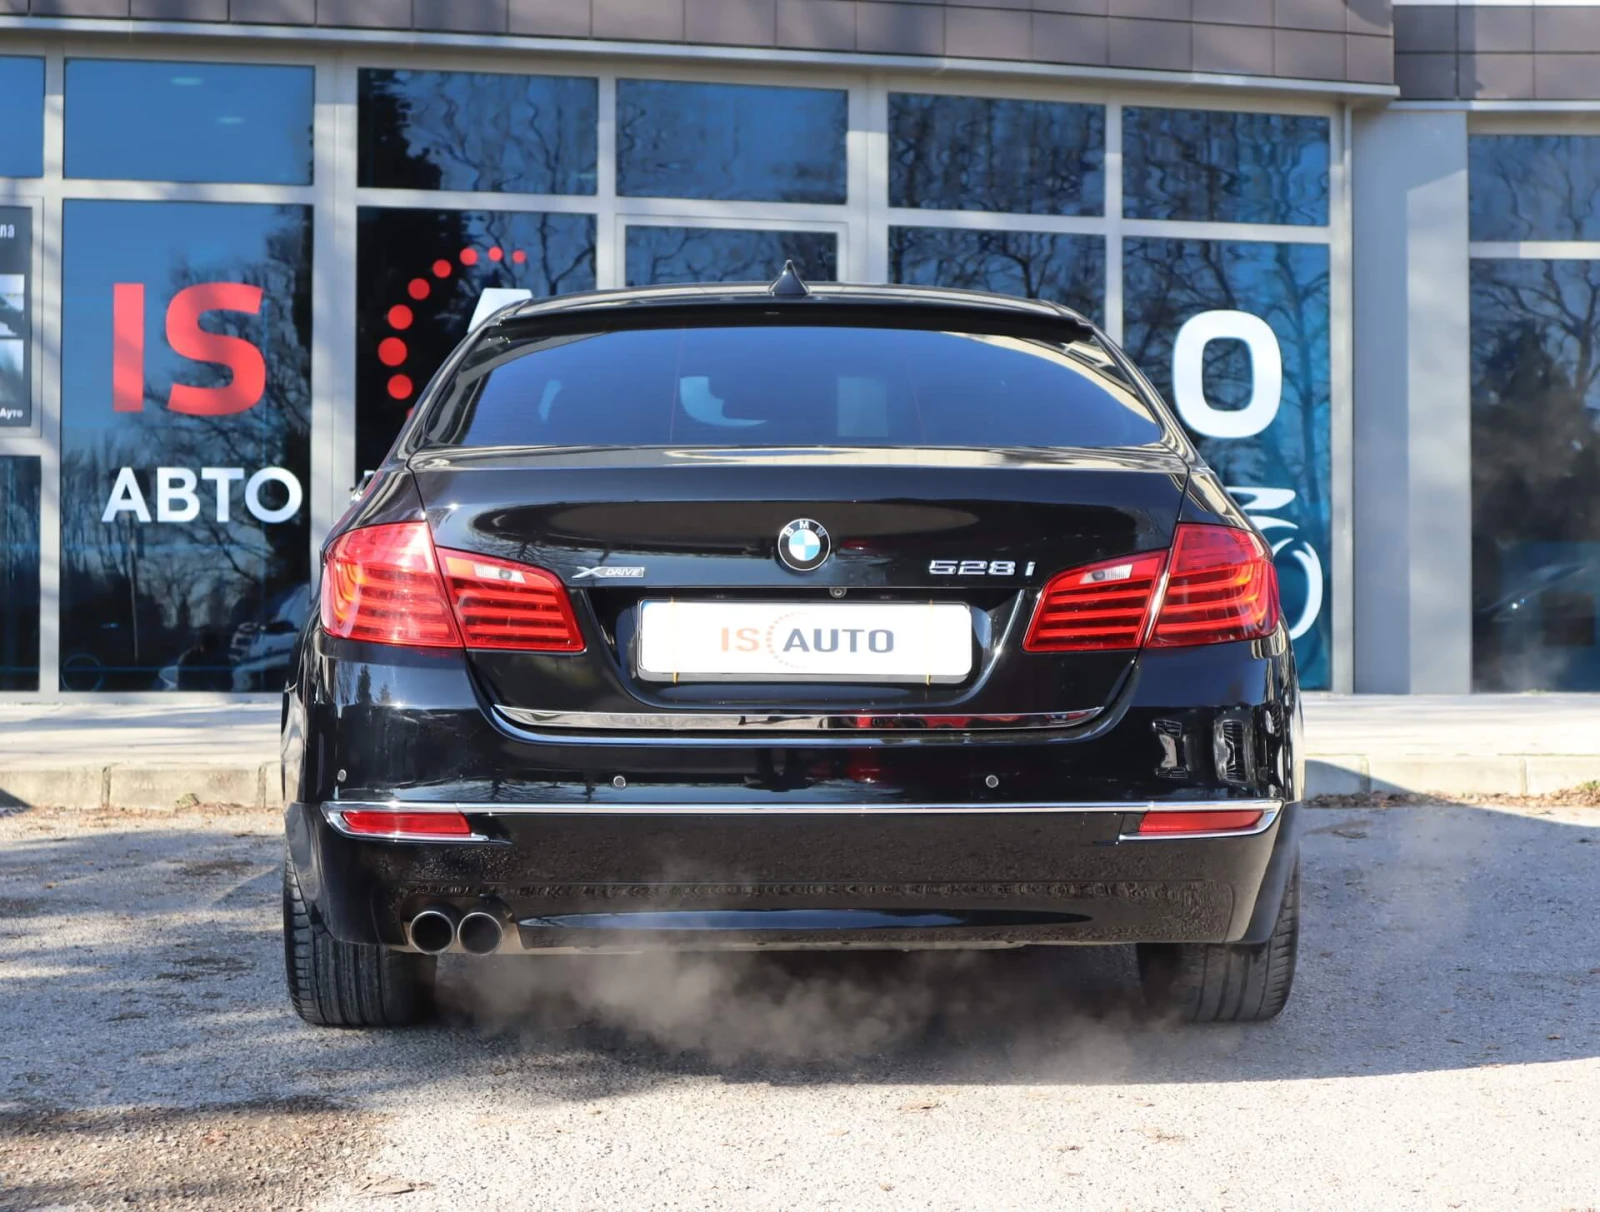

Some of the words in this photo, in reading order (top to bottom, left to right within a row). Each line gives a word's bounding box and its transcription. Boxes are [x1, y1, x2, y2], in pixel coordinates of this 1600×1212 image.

[112, 282, 266, 416] IS
[782, 520, 827, 537] BMW
[720, 627, 760, 652] IS
[783, 628, 895, 653] AUTO
